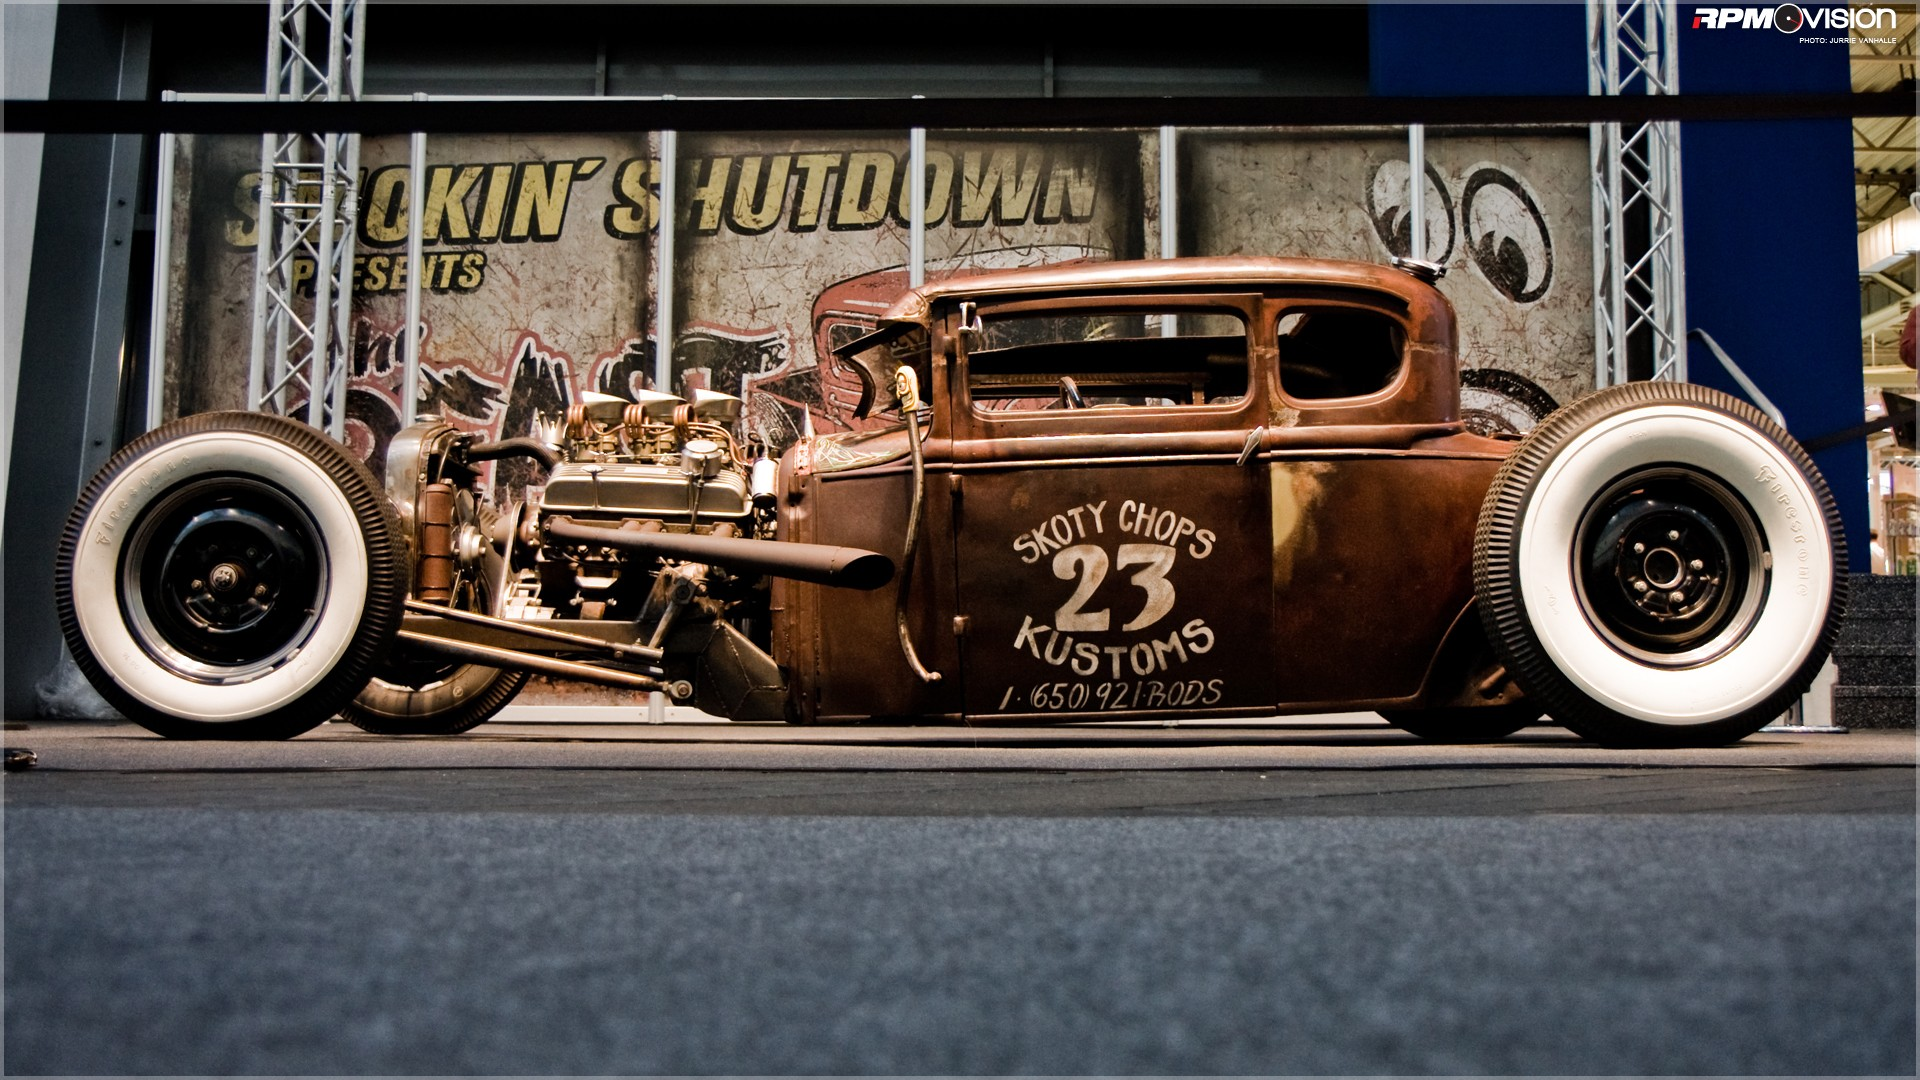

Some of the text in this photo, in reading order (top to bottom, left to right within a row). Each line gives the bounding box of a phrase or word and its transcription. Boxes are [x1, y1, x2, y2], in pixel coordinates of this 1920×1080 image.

[604, 150, 1100, 240] SHUTDOWN
[292, 252, 488, 296] PESENTS
[1013, 500, 1216, 564] SKOTY CHOPS
[1052, 544, 1176, 632] 23
[1013, 615, 1215, 680] KUSTOMS
